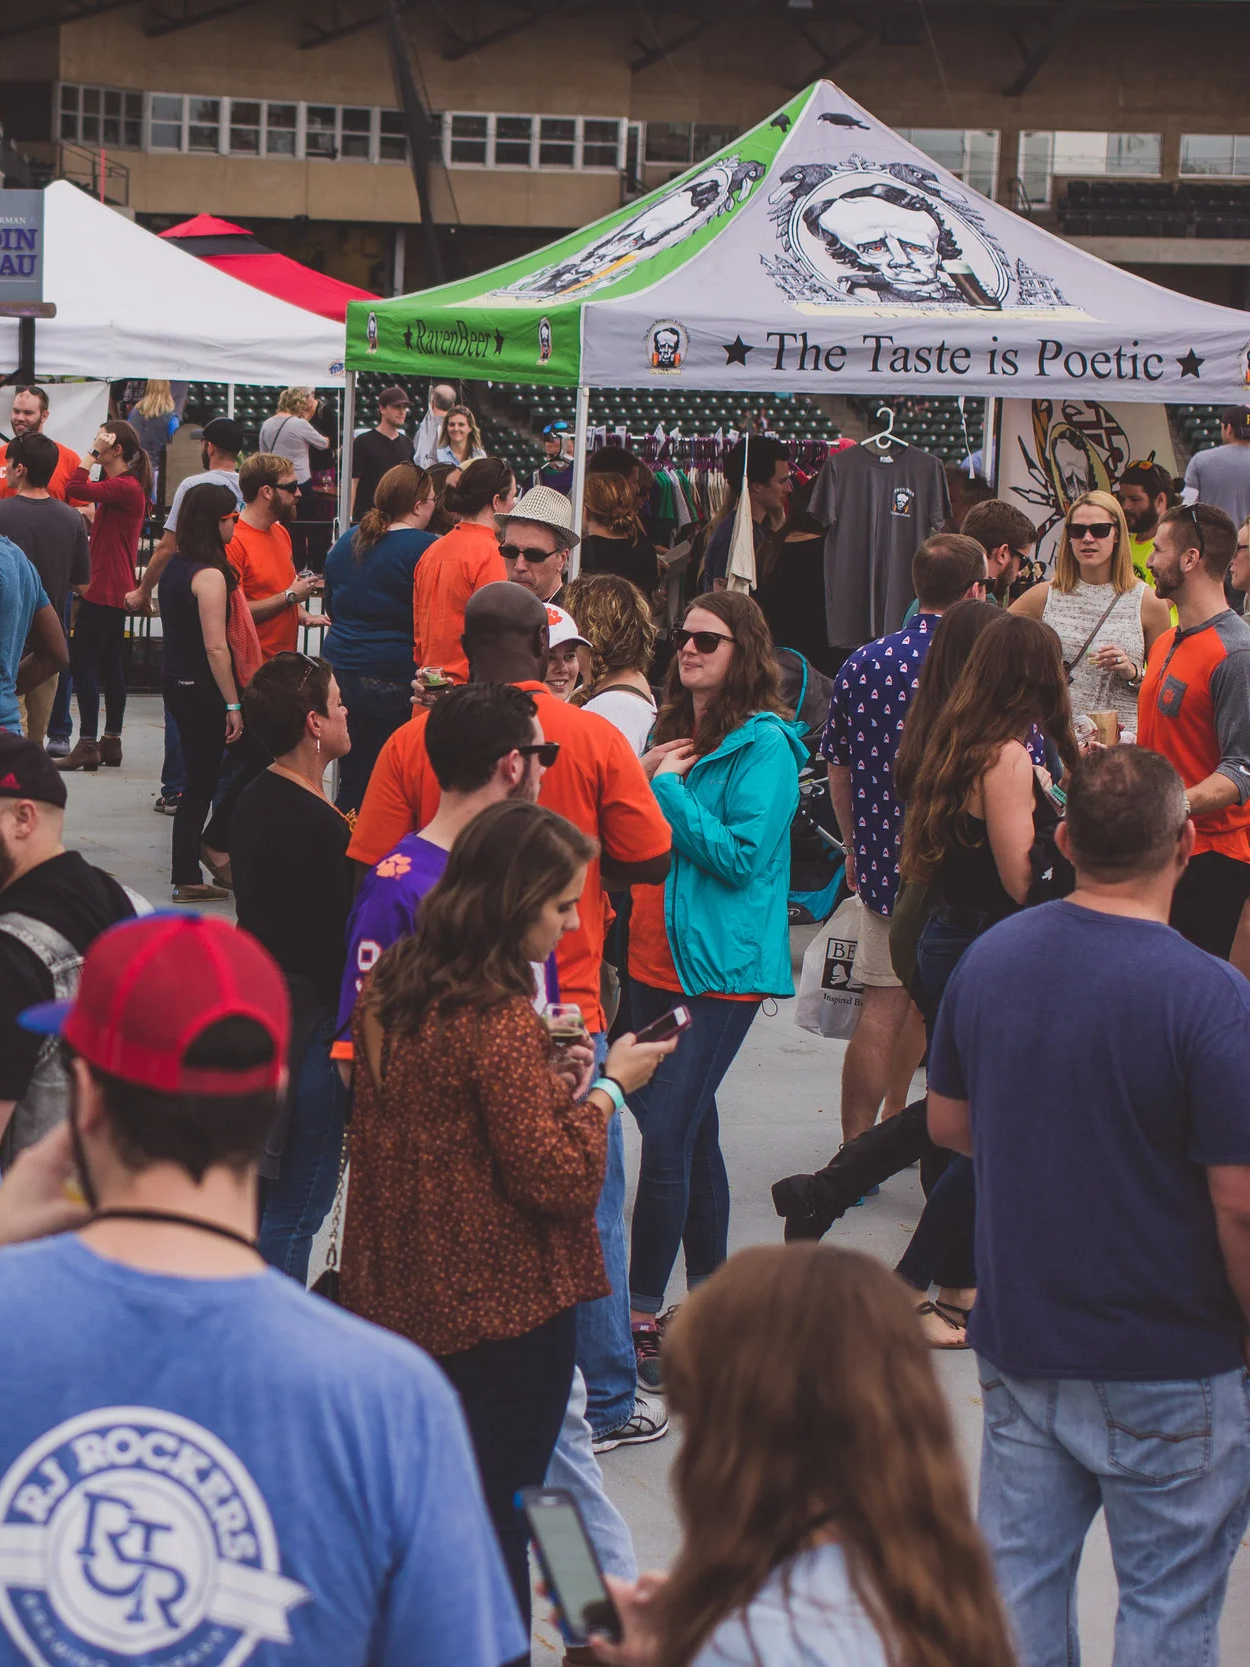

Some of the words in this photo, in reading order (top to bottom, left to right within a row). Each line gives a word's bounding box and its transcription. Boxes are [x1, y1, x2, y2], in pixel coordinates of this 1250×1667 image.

[416, 319, 491, 358] RavenBeer
[766, 332, 848, 372] The
[862, 334, 971, 375] Taste
[987, 336, 1019, 376] is
[1035, 338, 1164, 382] Poetic
[823, 992, 852, 1006] Inspired
[13, 1456, 70, 1522] RJ
[71, 1426, 258, 1562] ROCKERS
